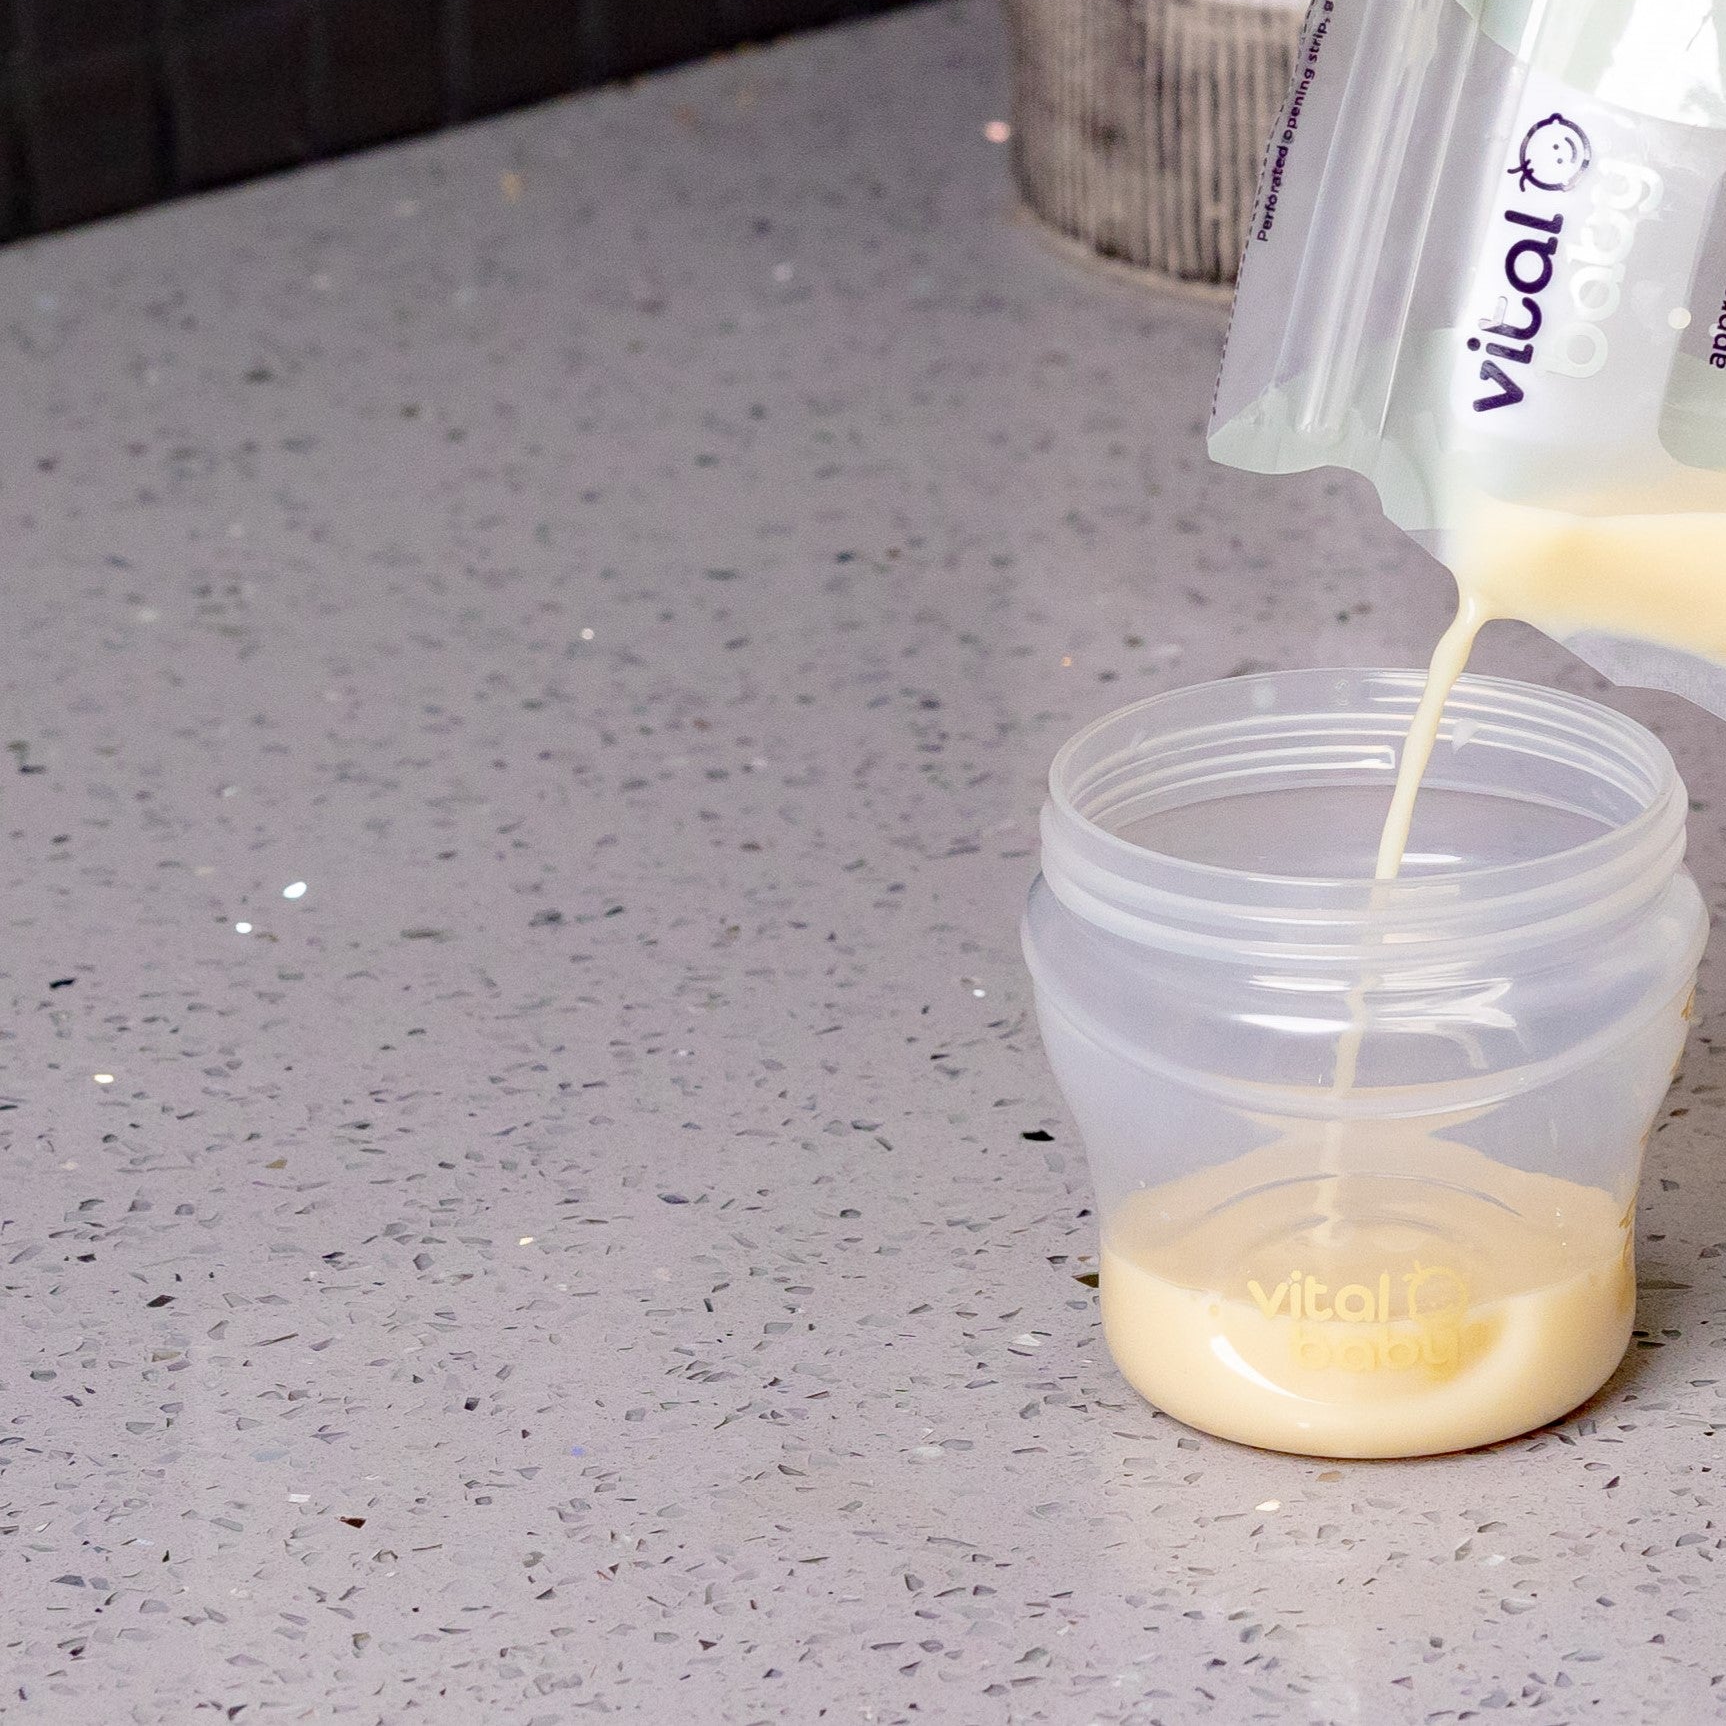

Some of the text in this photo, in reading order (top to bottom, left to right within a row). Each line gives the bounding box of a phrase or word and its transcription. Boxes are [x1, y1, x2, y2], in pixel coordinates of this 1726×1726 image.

[1256, 144, 1291, 242] Perforated
[1283, 66, 1315, 142] opening
[1307, 17, 1331, 64] strip,
[1466, 209, 1564, 413] vital
[1543, 160, 1665, 379] baby
[1246, 1269, 1391, 1323] vital
